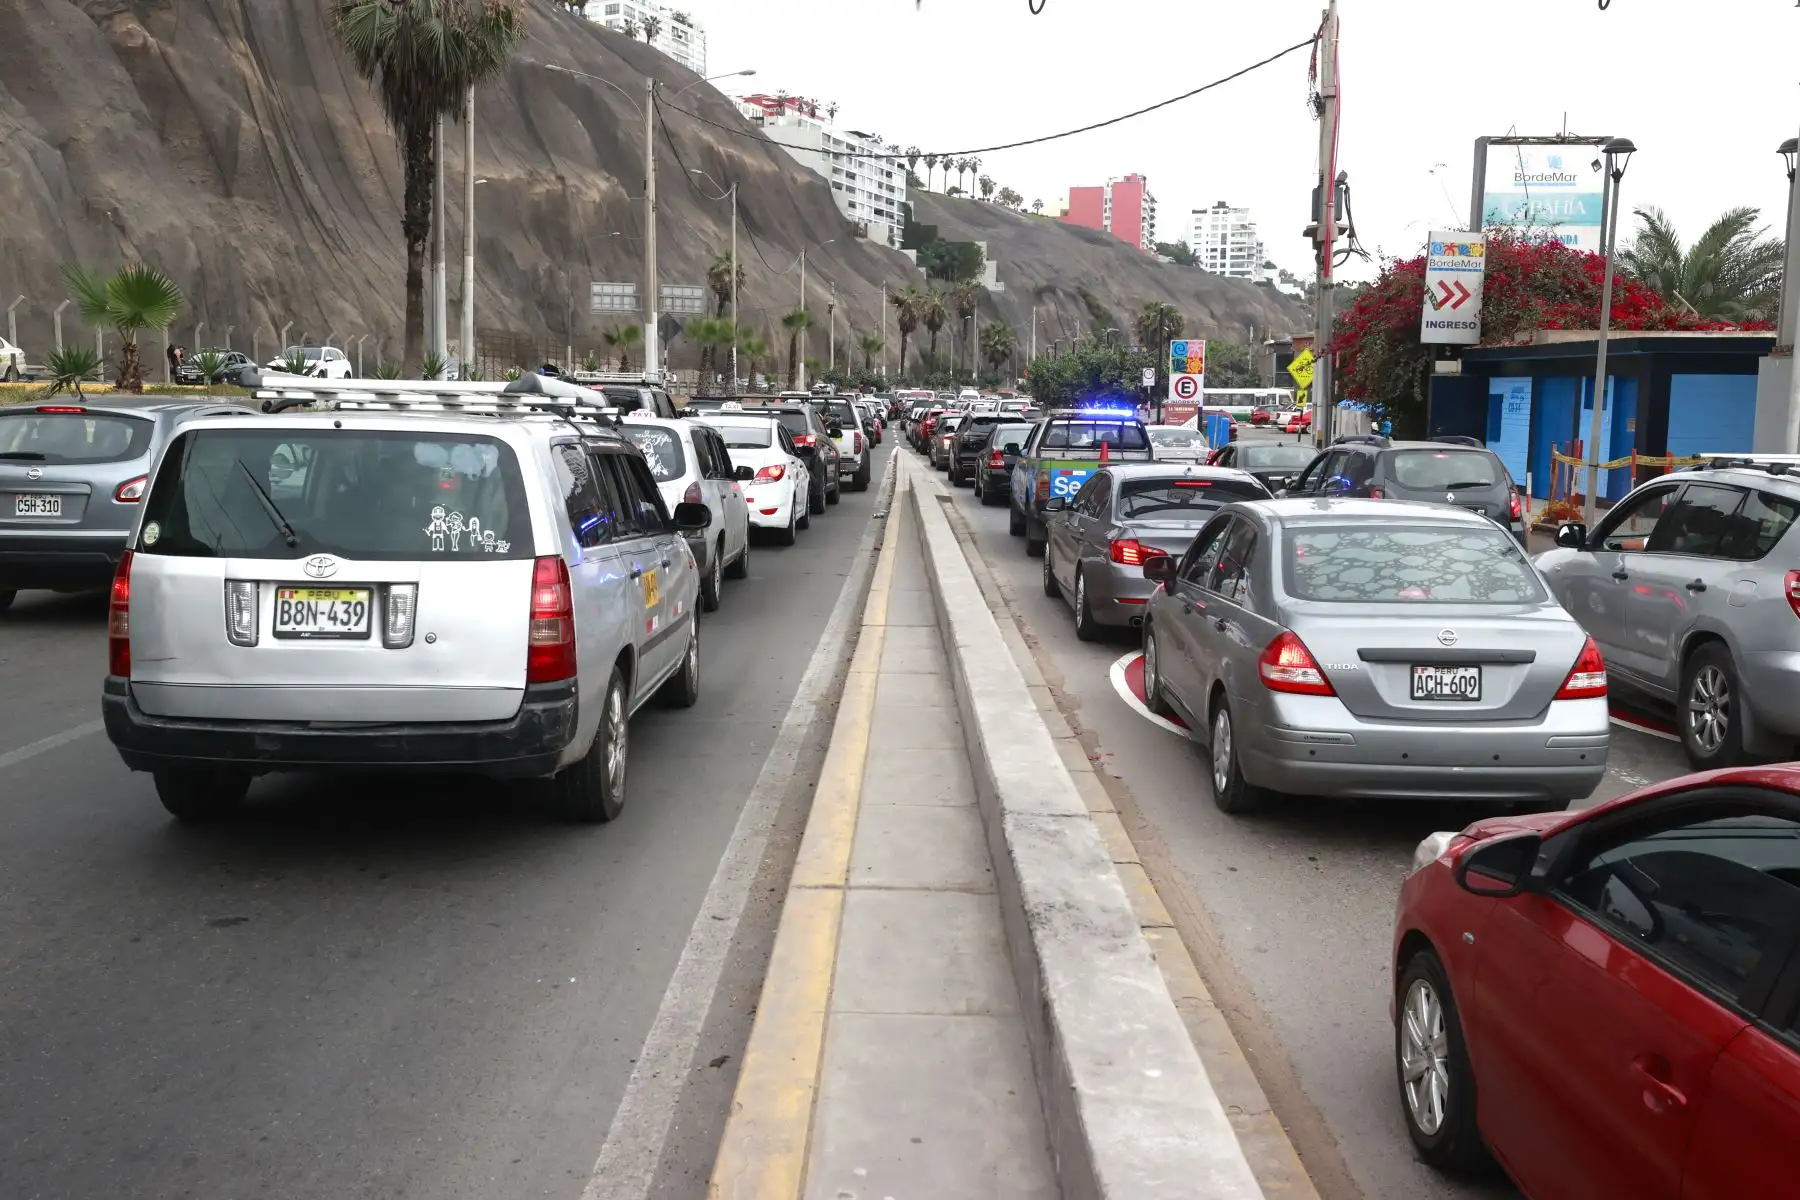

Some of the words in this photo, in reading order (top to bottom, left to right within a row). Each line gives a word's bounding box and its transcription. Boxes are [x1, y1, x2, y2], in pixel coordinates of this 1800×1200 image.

[1514, 172, 1577, 182] BordeMar
[1429, 259, 1481, 268] BordeMar
[1426, 321, 1477, 330] INGRESO
[1181, 381, 1191, 394] E
[17, 500, 59, 512] C5H-310
[279, 600, 365, 626] B8N-439
[1415, 675, 1477, 695] ACH-609
